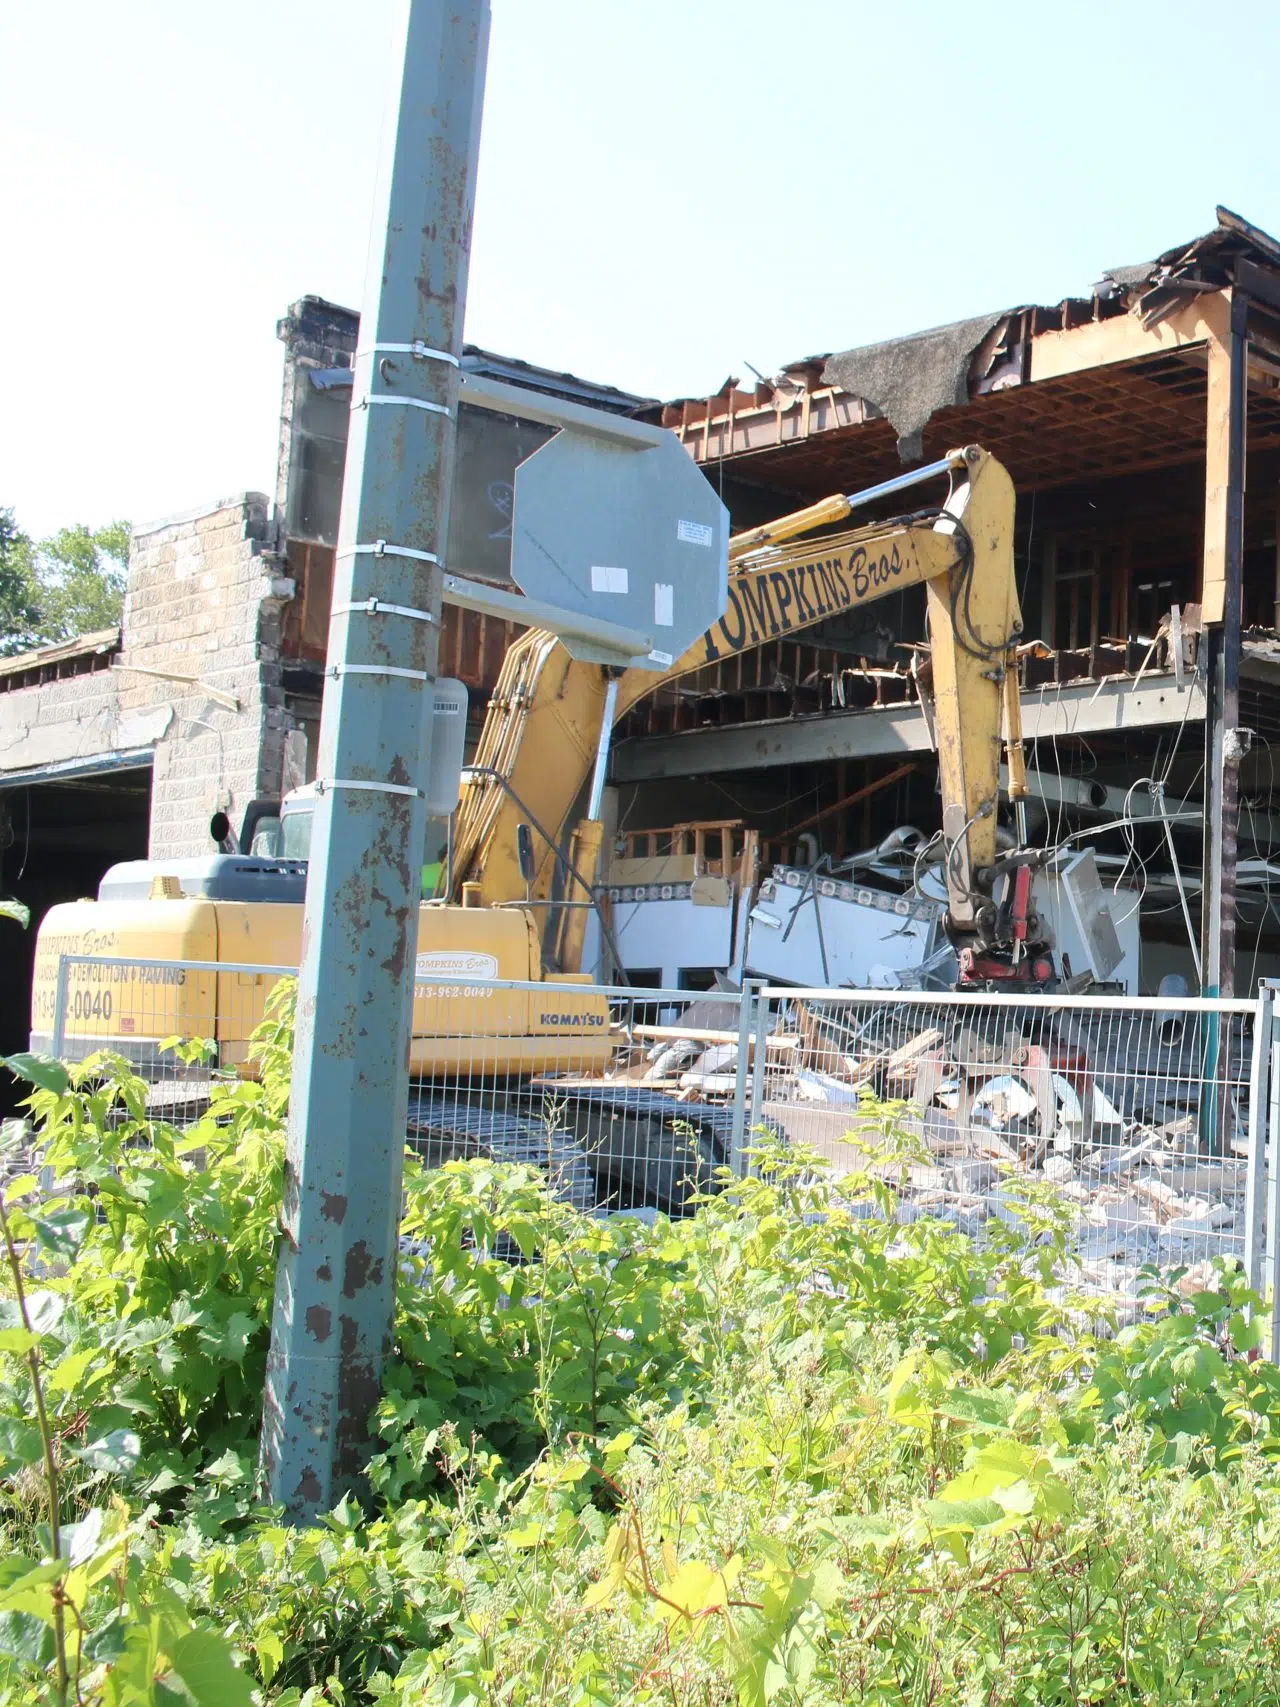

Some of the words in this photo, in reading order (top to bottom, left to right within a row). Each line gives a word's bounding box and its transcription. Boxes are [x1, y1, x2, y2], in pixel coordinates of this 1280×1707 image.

[848, 542, 911, 598] Bros.
[139, 966, 186, 986] PAVING
[34, 990, 112, 1021] 613-9-0040
[540, 1012, 605, 1026] KOMATSU
